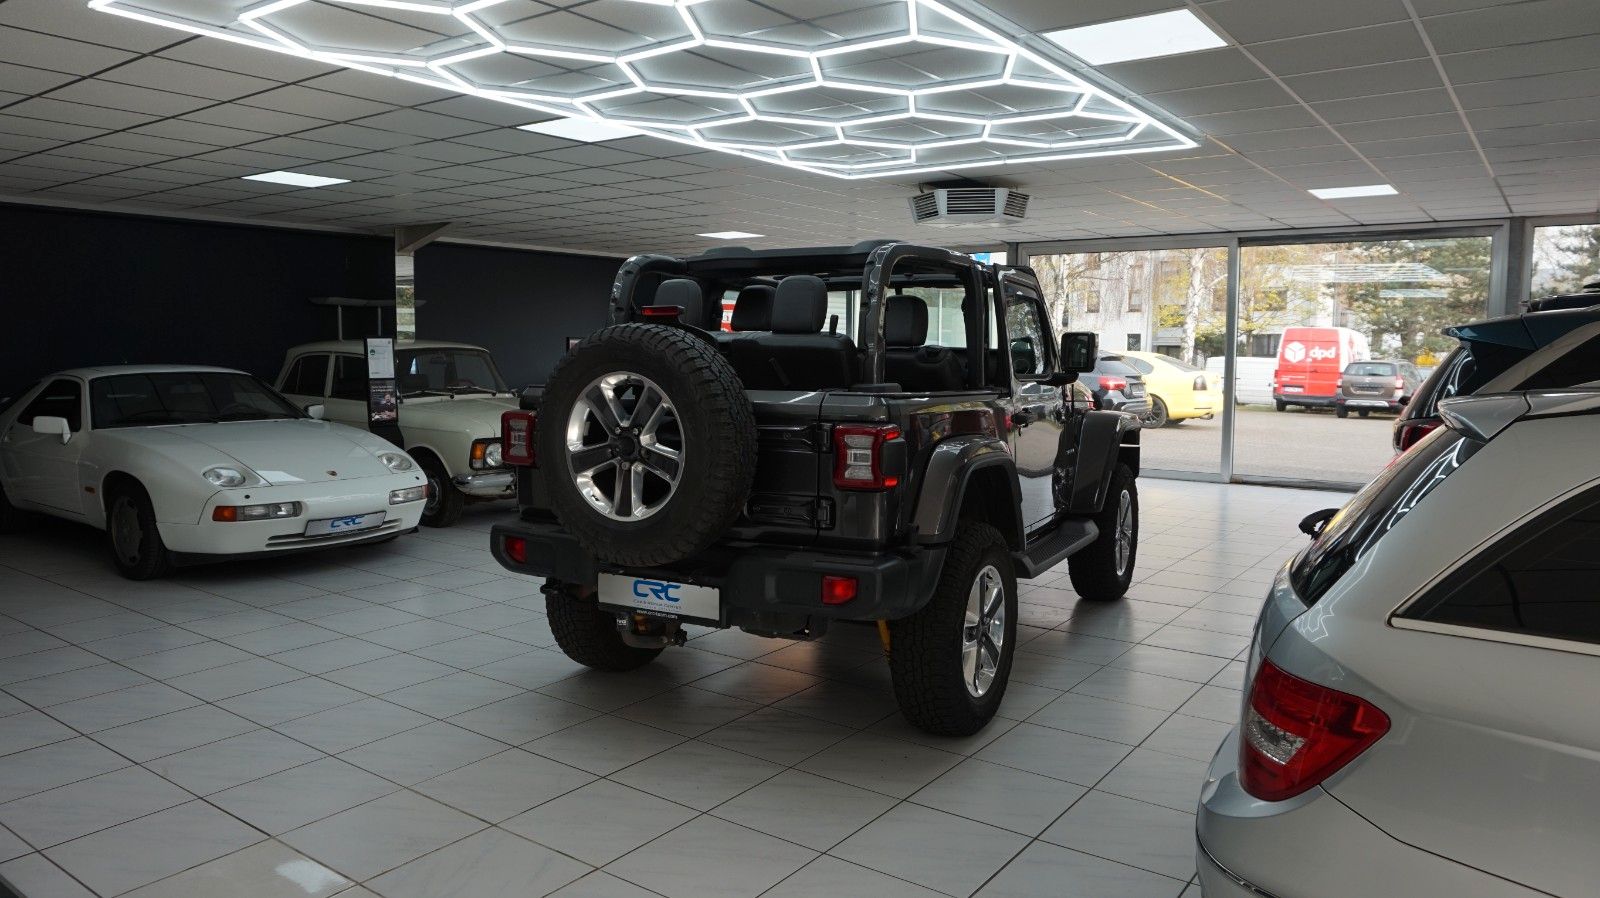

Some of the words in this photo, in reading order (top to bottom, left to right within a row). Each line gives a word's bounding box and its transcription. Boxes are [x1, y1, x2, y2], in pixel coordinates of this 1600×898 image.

[1309, 346, 1336, 360] dpd
[331, 515, 365, 528] CRC
[633, 579, 682, 602] CRC
